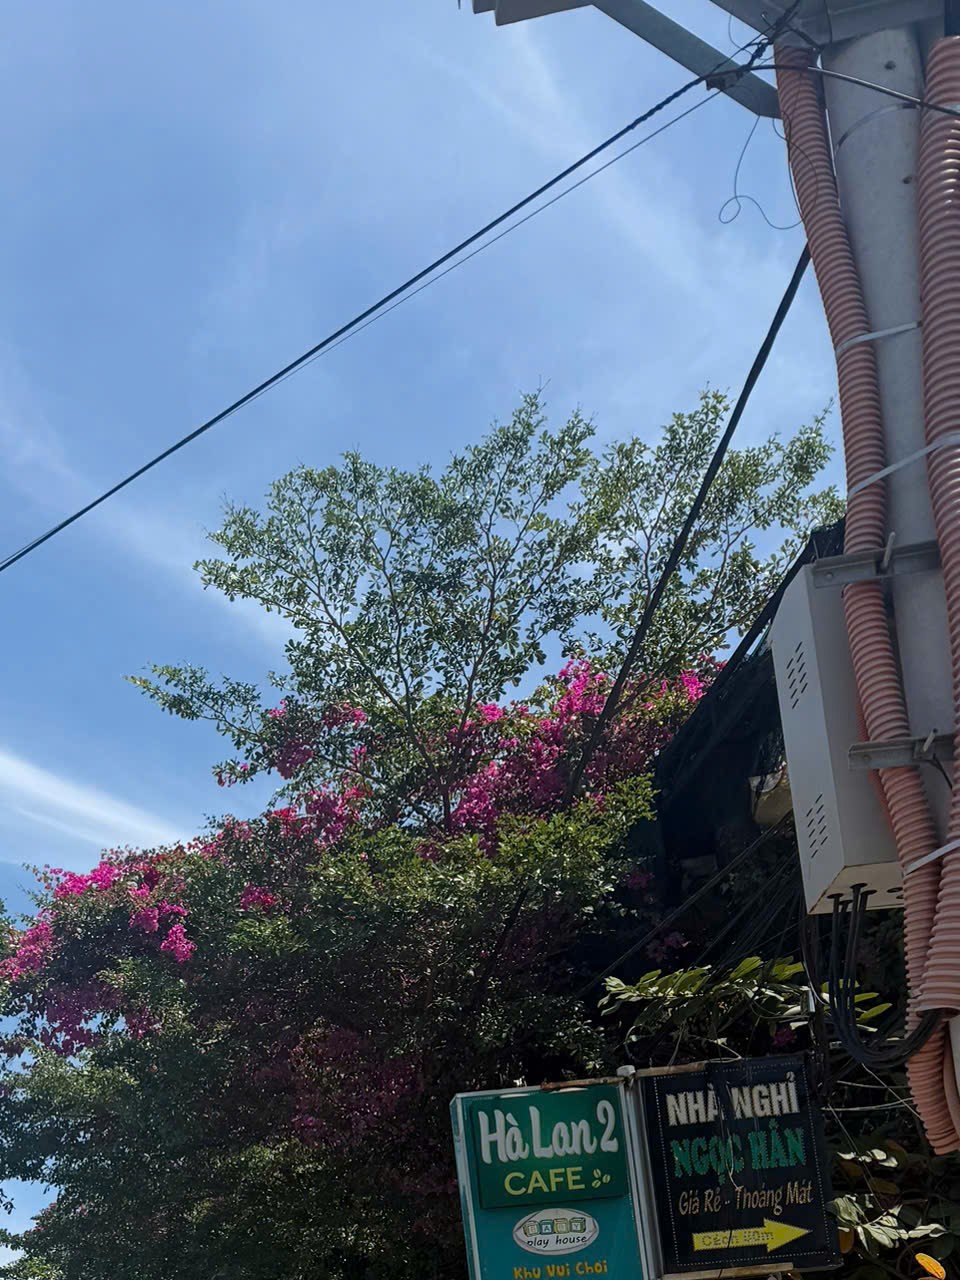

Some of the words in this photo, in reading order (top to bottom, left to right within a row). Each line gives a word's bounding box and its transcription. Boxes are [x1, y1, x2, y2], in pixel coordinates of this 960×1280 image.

[477, 1108, 530, 1164] Hà
[529, 1105, 597, 1158] Lan
[596, 1099, 619, 1152] 2
[503, 1166, 585, 1196] CAFE
[678, 1189, 700, 1216] Giá
[785, 1179, 815, 1206] Mát
[526, 1236, 549, 1248] play
[555, 1234, 587, 1245] house
